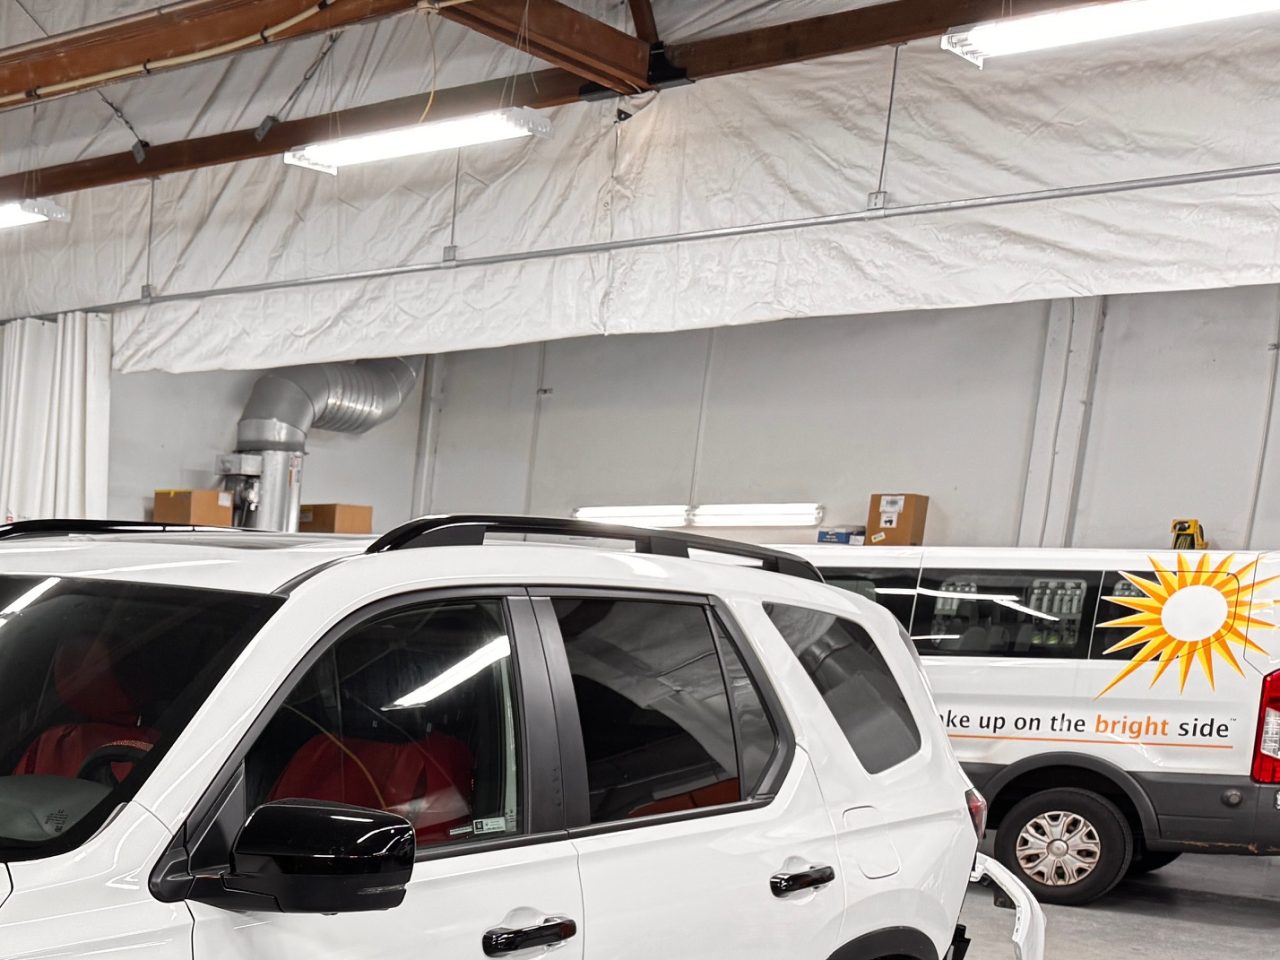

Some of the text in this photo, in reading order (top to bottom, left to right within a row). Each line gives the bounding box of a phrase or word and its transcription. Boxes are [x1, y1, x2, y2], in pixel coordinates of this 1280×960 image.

[978, 716, 1006, 734] up
[1014, 717, 1041, 732] on
[1049, 713, 1086, 733] the
[1095, 714, 1169, 739] bright
